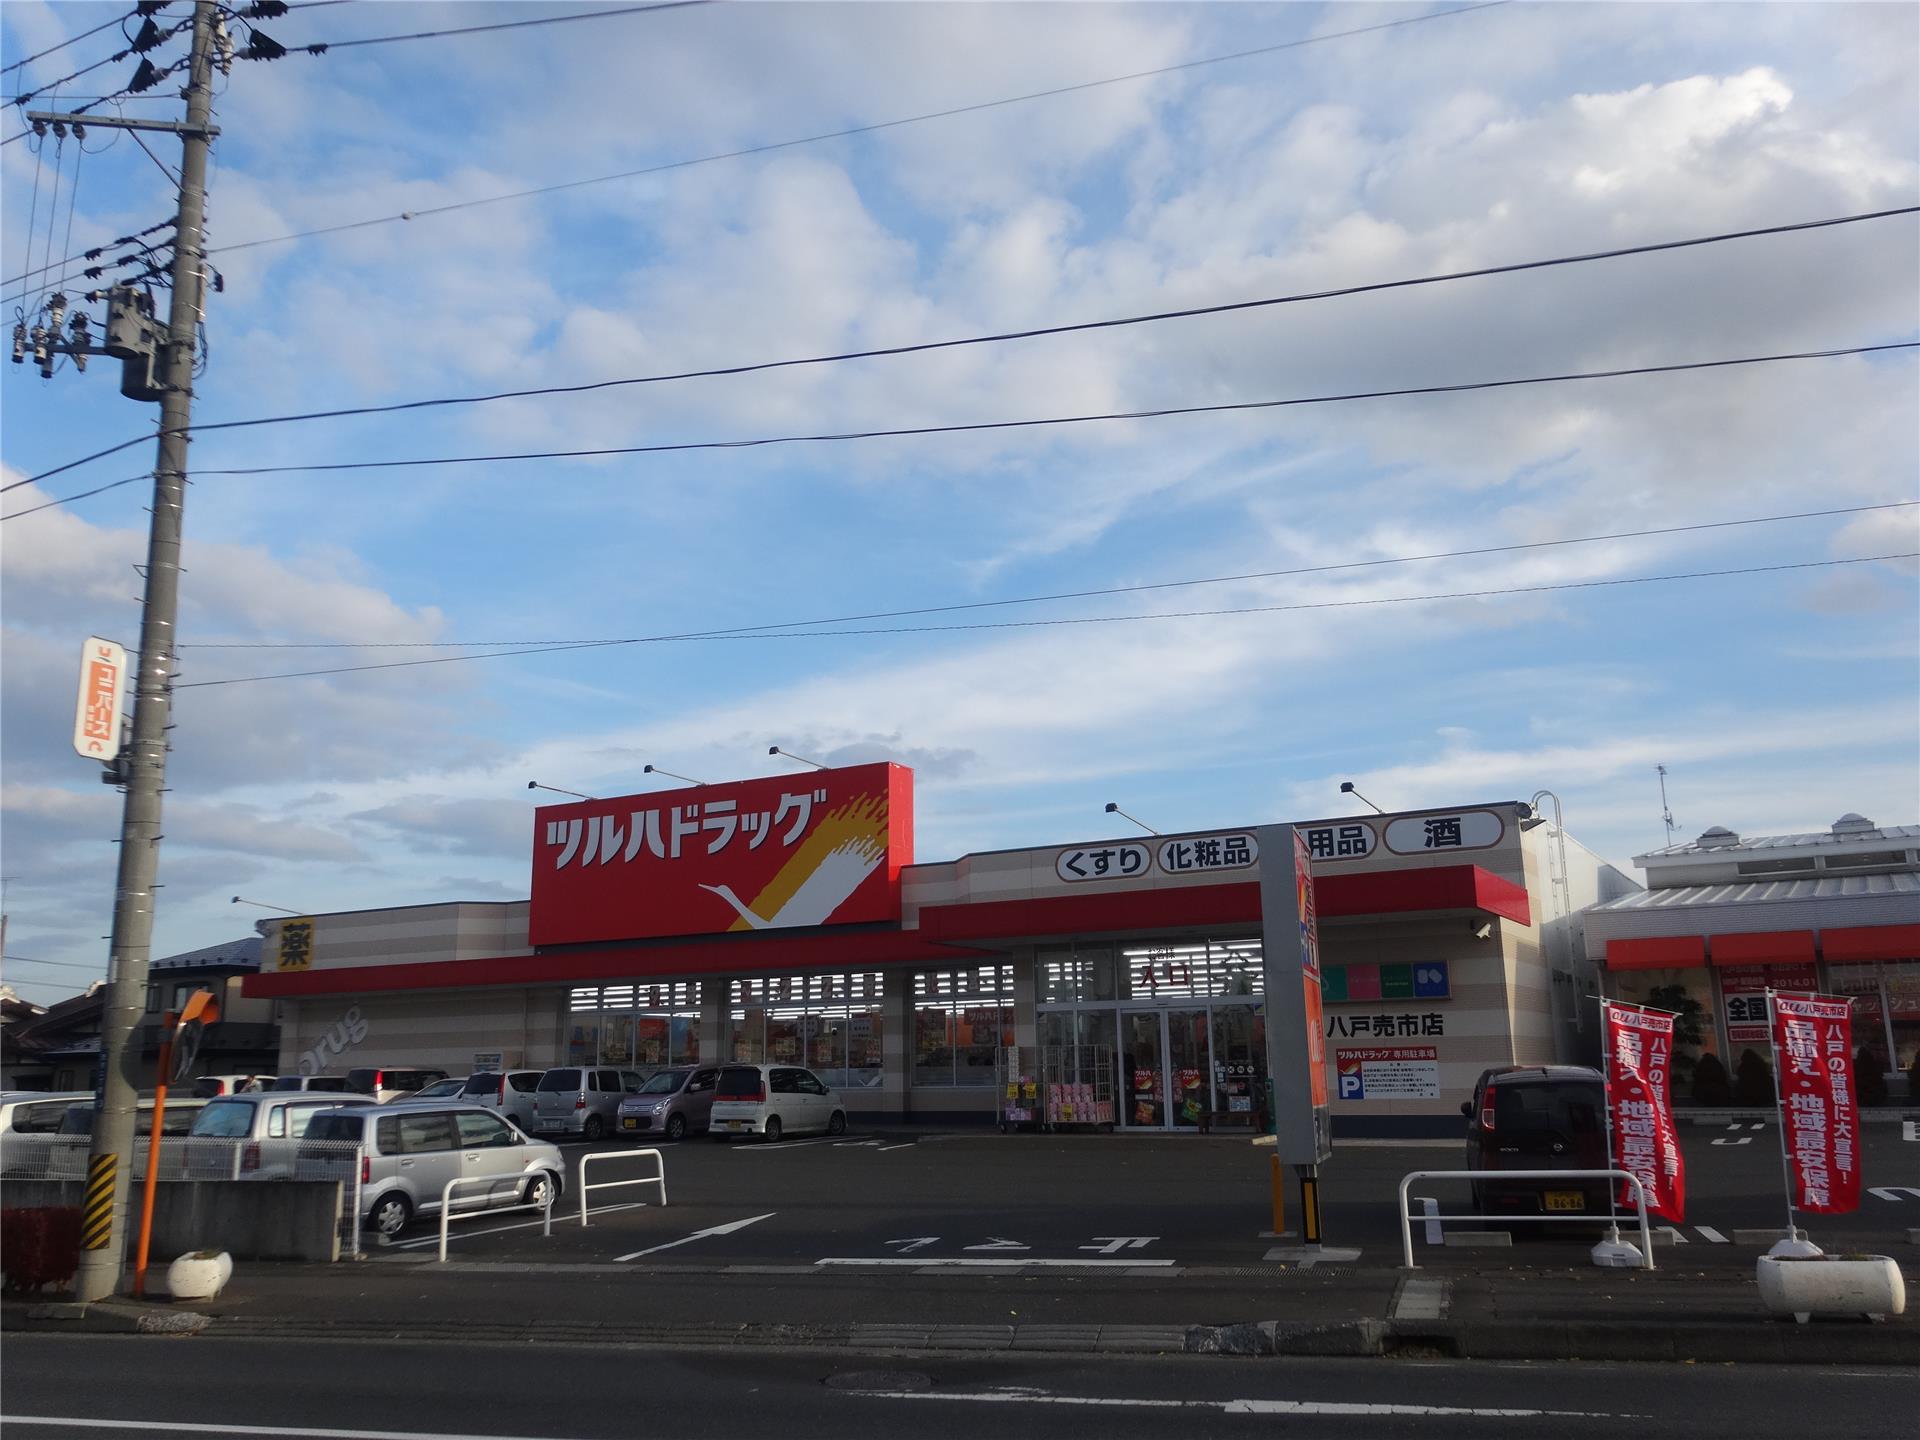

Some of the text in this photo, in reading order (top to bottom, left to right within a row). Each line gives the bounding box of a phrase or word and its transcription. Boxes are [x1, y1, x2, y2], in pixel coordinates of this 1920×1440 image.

[546, 788, 827, 870] ツルハドラッグ
[1423, 817, 1462, 848] 酒
[1065, 847, 1142, 879] くすり
[1166, 836, 1251, 870] 化粧品
[280, 923, 312, 966] 薬
[1137, 964, 1188, 987] 入口
[1727, 996, 1767, 1021] 全国
[1327, 1013, 1444, 1038] 八戸売市店
[1337, 1050, 1392, 1059] ツルハドラッグ
[1341, 1076, 1360, 1098] P
